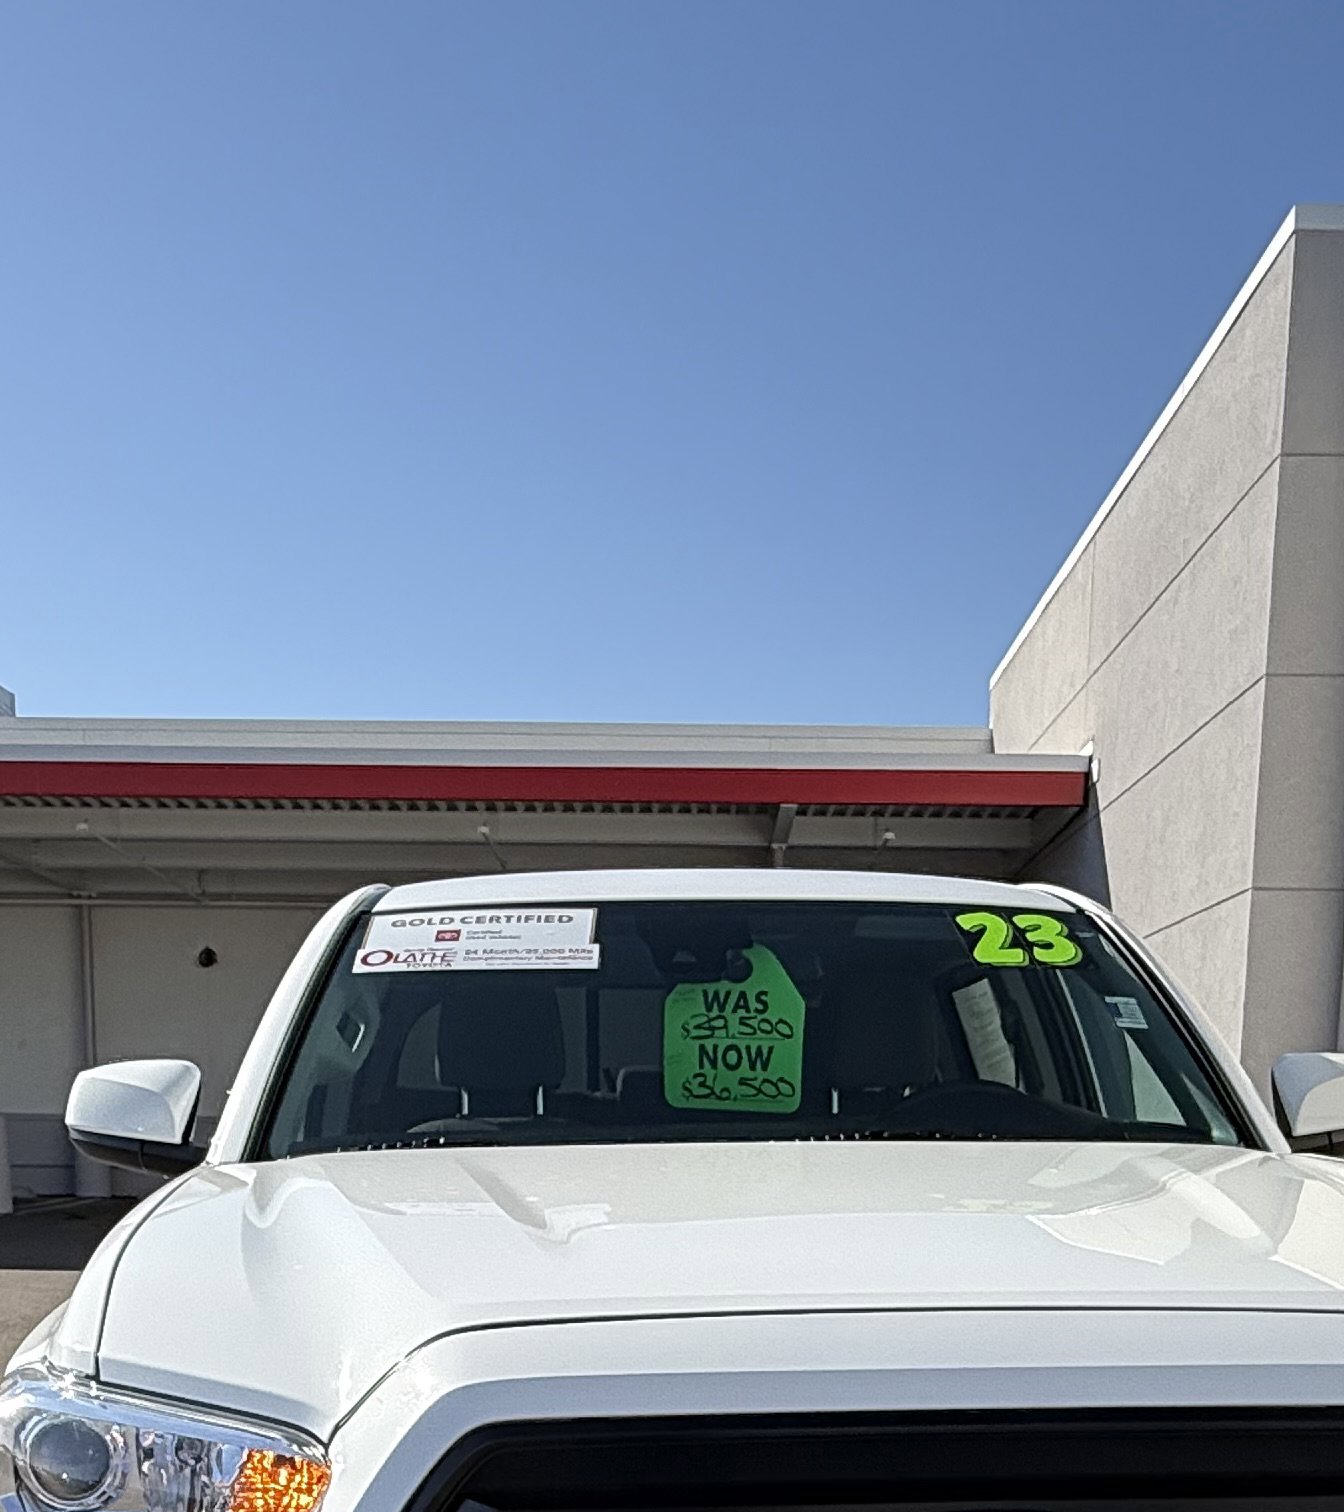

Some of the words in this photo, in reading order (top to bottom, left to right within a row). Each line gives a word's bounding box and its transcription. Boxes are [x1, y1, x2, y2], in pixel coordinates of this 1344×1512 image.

[390, 916, 455, 928] GOLD
[459, 914, 574, 925] CERTIFIED
[955, 911, 1083, 967] 23
[360, 949, 458, 968] OLATHE
[701, 988, 770, 1015] WAS
[697, 1043, 775, 1072] NOW
